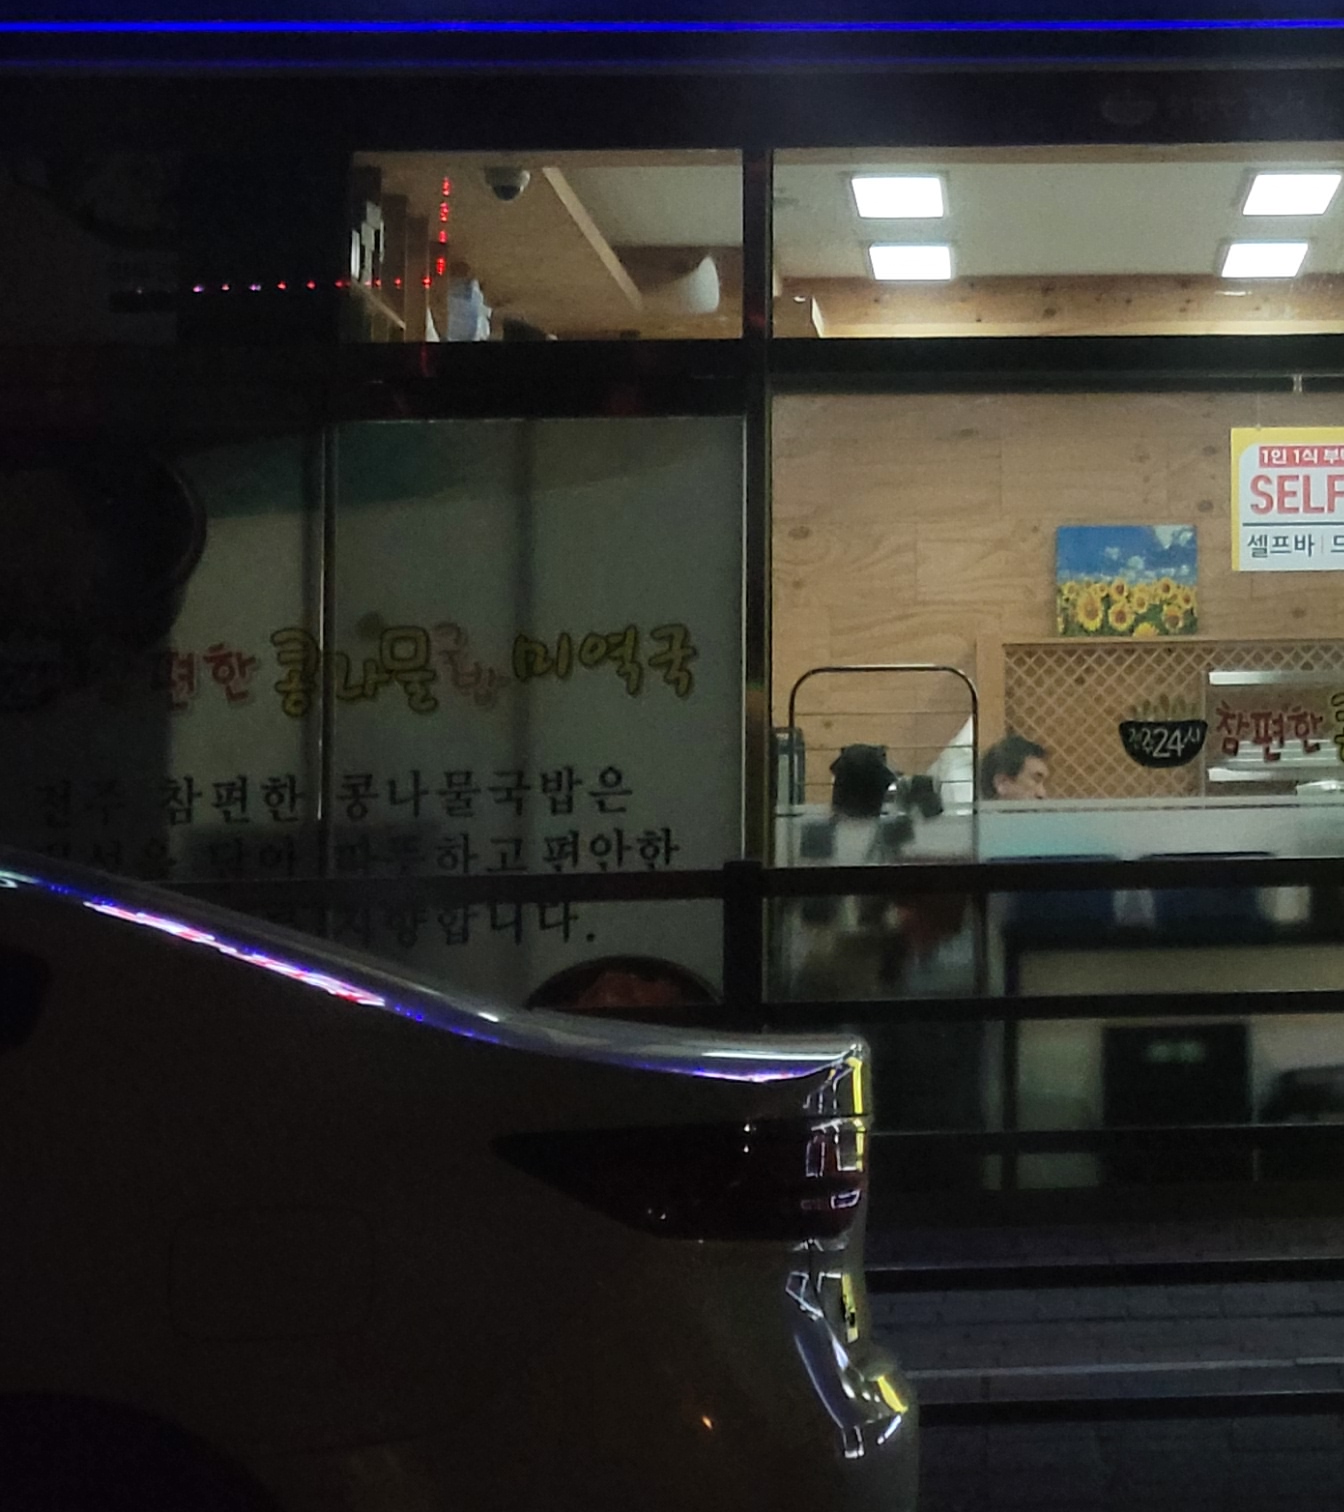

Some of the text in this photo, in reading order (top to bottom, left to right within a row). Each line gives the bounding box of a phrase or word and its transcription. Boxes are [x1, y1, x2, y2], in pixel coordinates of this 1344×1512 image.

[1247, 534, 1316, 559] 셀프바
[1216, 700, 1323, 762] 참편한
[336, 767, 634, 821] 콩나물국밥은
